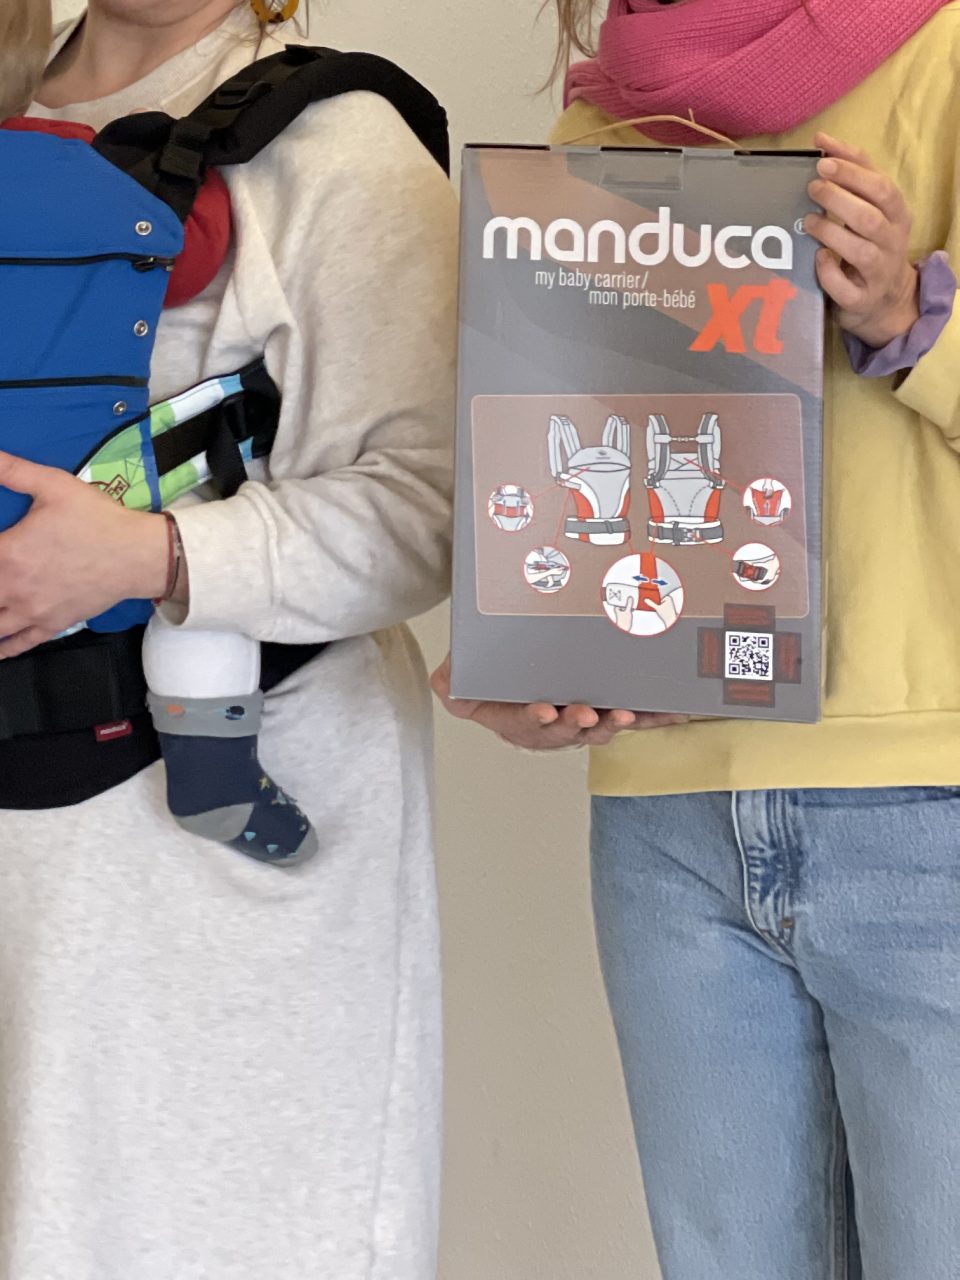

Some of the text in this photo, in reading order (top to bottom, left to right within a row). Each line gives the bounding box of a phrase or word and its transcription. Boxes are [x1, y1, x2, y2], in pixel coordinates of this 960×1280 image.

[483, 206, 794, 269] manduca
[535, 270, 649, 290] my baby carrier/
[589, 289, 696, 309] mon porte-bébé
